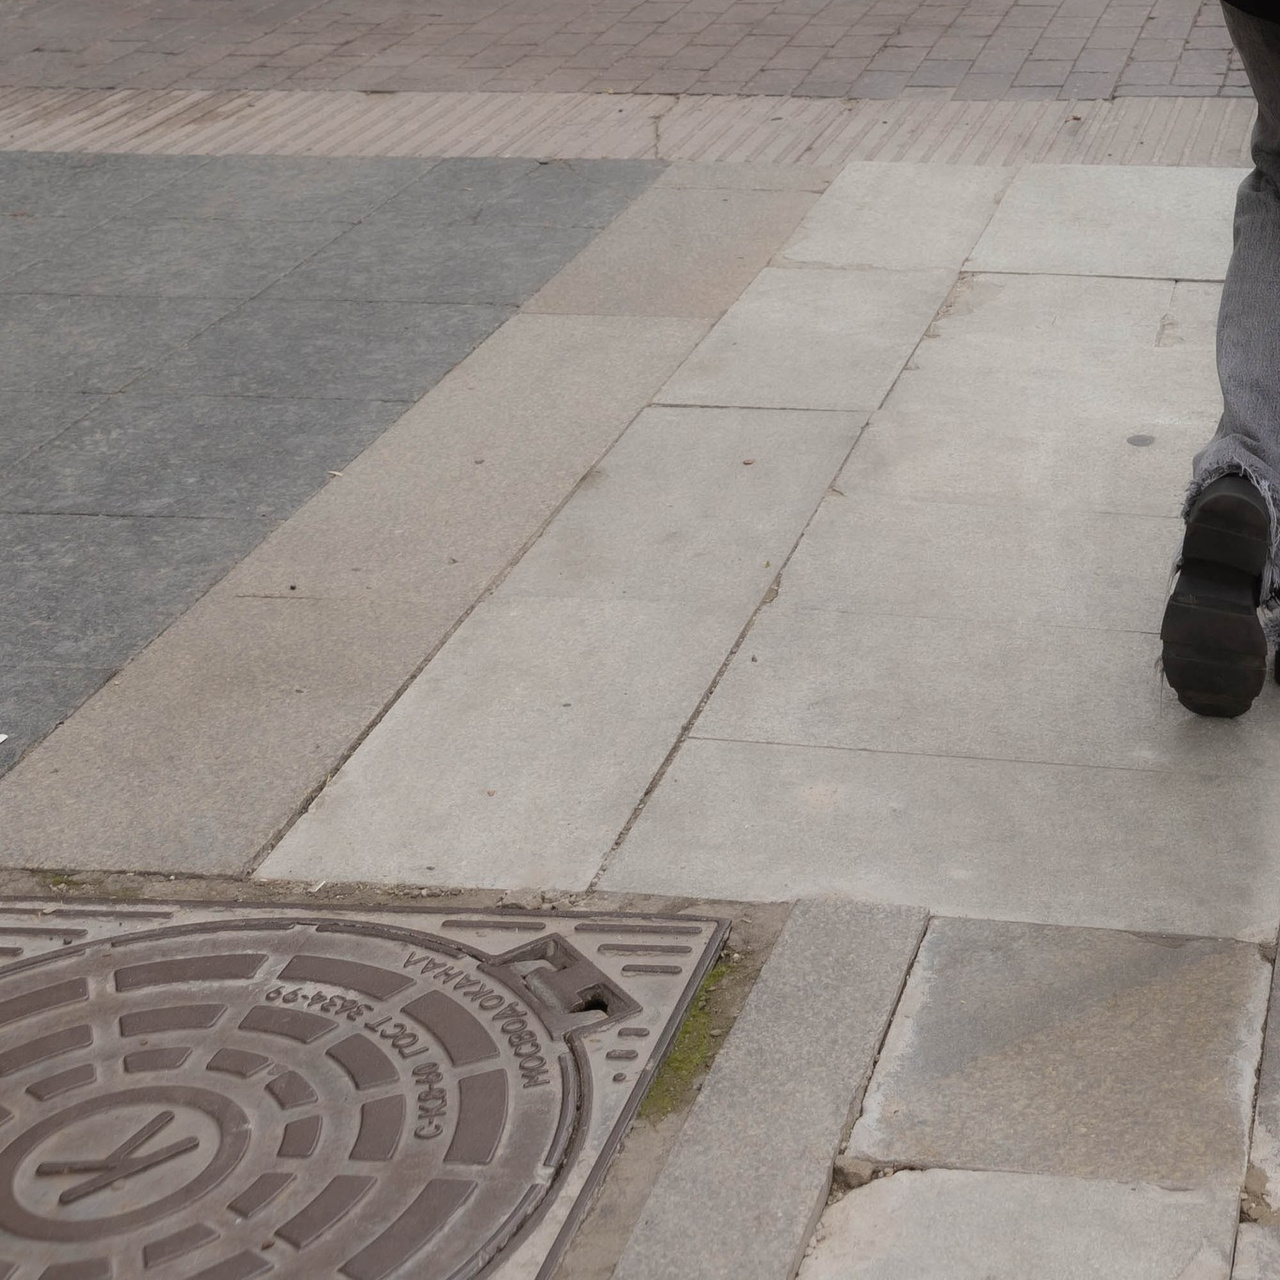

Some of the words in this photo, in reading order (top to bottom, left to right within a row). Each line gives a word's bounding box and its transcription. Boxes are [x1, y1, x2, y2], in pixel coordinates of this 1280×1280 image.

[264, 986, 374, 1022] 3634-99
[402, 951, 550, 1089] МОСВОДОКАНАЛ
[364, 1015, 430, 1059] ГОСТ
